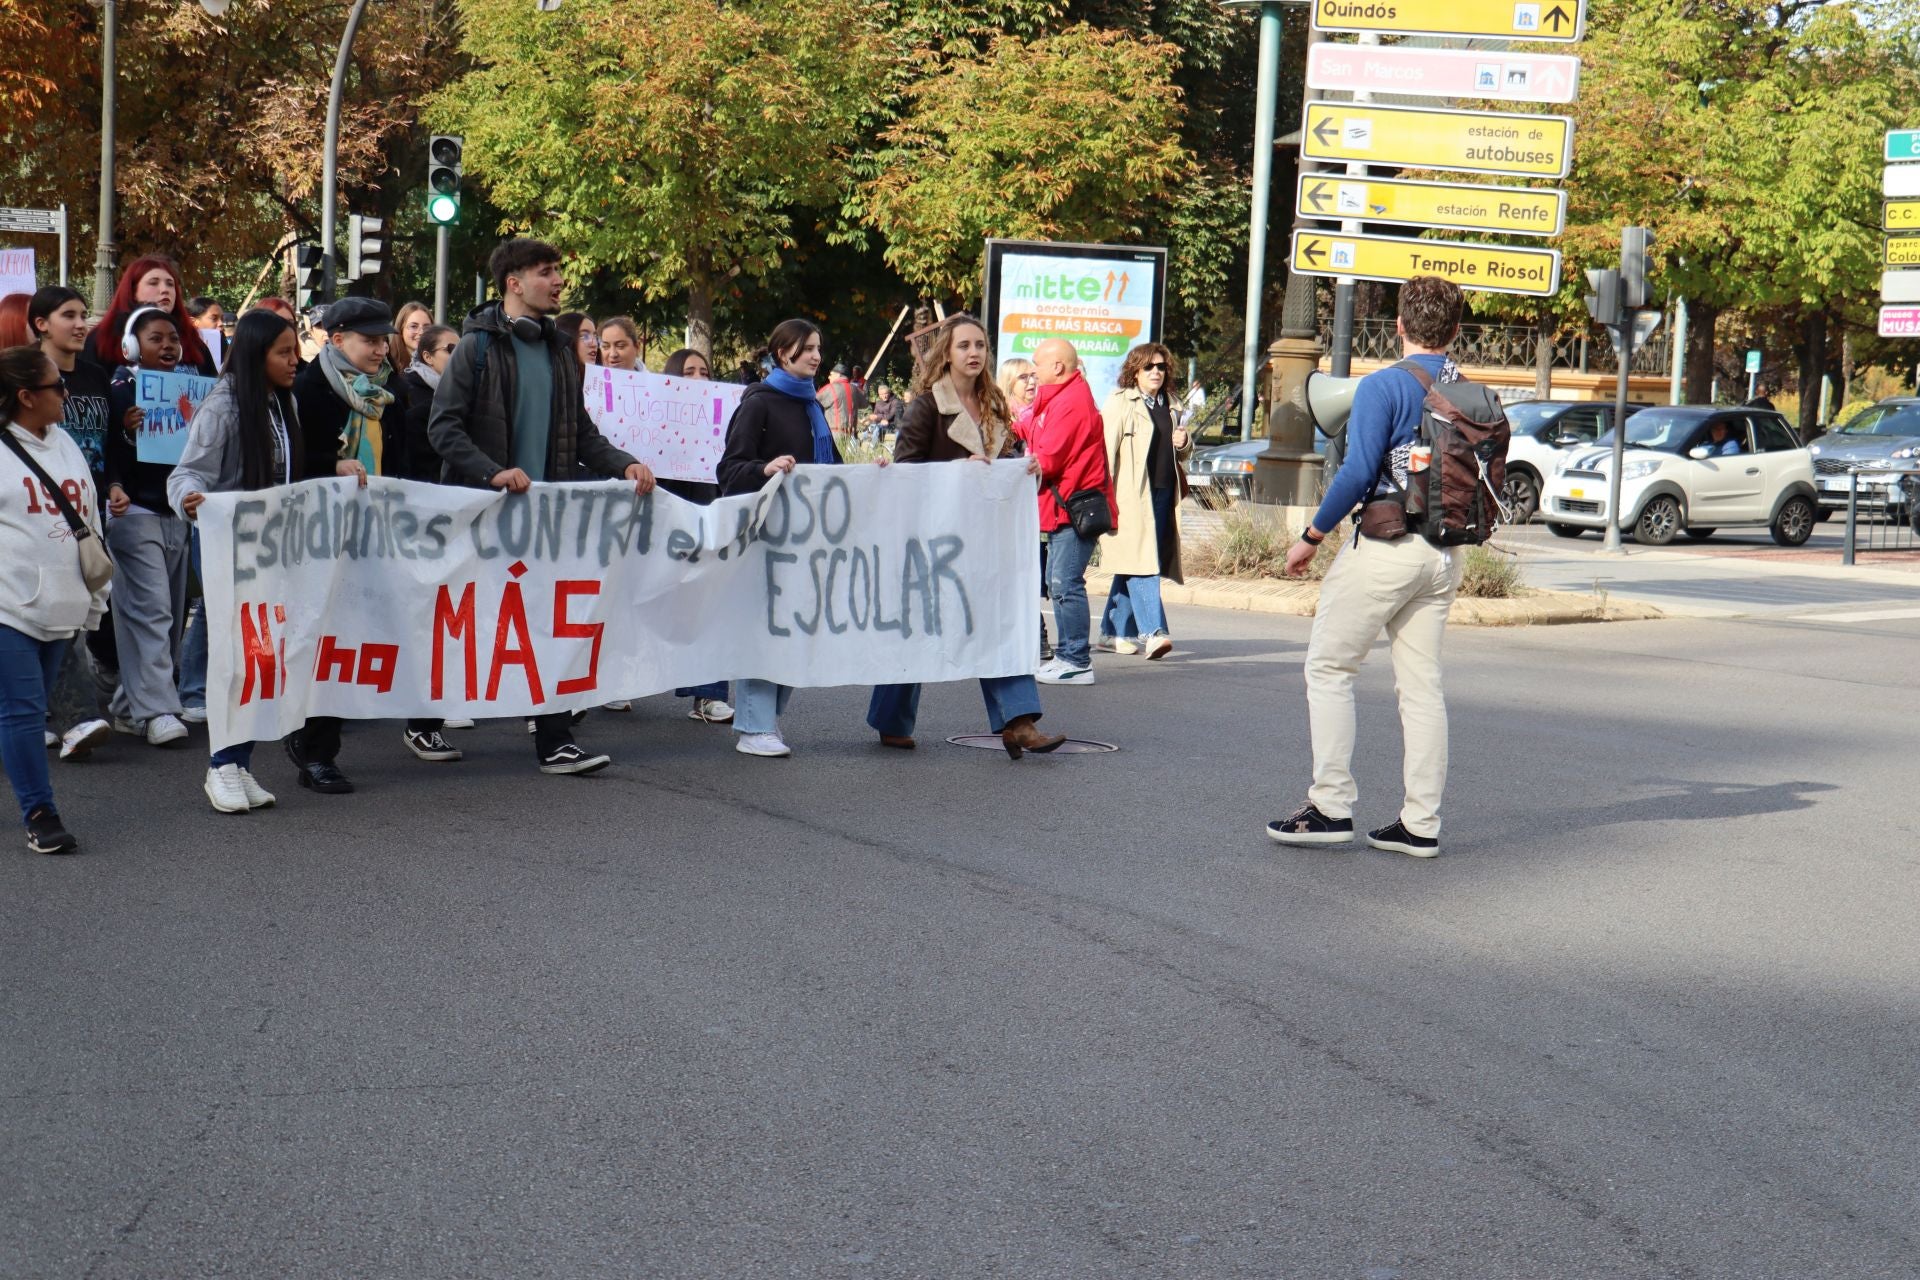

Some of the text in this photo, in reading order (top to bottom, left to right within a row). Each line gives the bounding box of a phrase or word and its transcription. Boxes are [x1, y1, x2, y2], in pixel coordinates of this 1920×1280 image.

[1323, 0, 1397, 20] Quindós
[1320, 59, 1424, 82] San Marcos
[1468, 124, 1544, 141] estación de
[1465, 146, 1555, 165] autobuses
[1436, 199, 1550, 222] estación Renfe
[1888, 240, 1920, 250] aparc
[1410, 254, 1545, 282] Temple Riosol
[1016, 273, 1102, 302] mitte
[1036, 303, 1110, 317] aerotermía
[1021, 317, 1123, 335] HACE MÁS RASCA
[142, 373, 171, 403] EL
[232, 480, 452, 586] Estudiantes
[471, 488, 657, 567] CONTRA
[666, 515, 705, 564] el
[764, 534, 975, 640] ESCOLAR
[240, 601, 287, 707] Ni
[429, 559, 605, 706] MÁS
